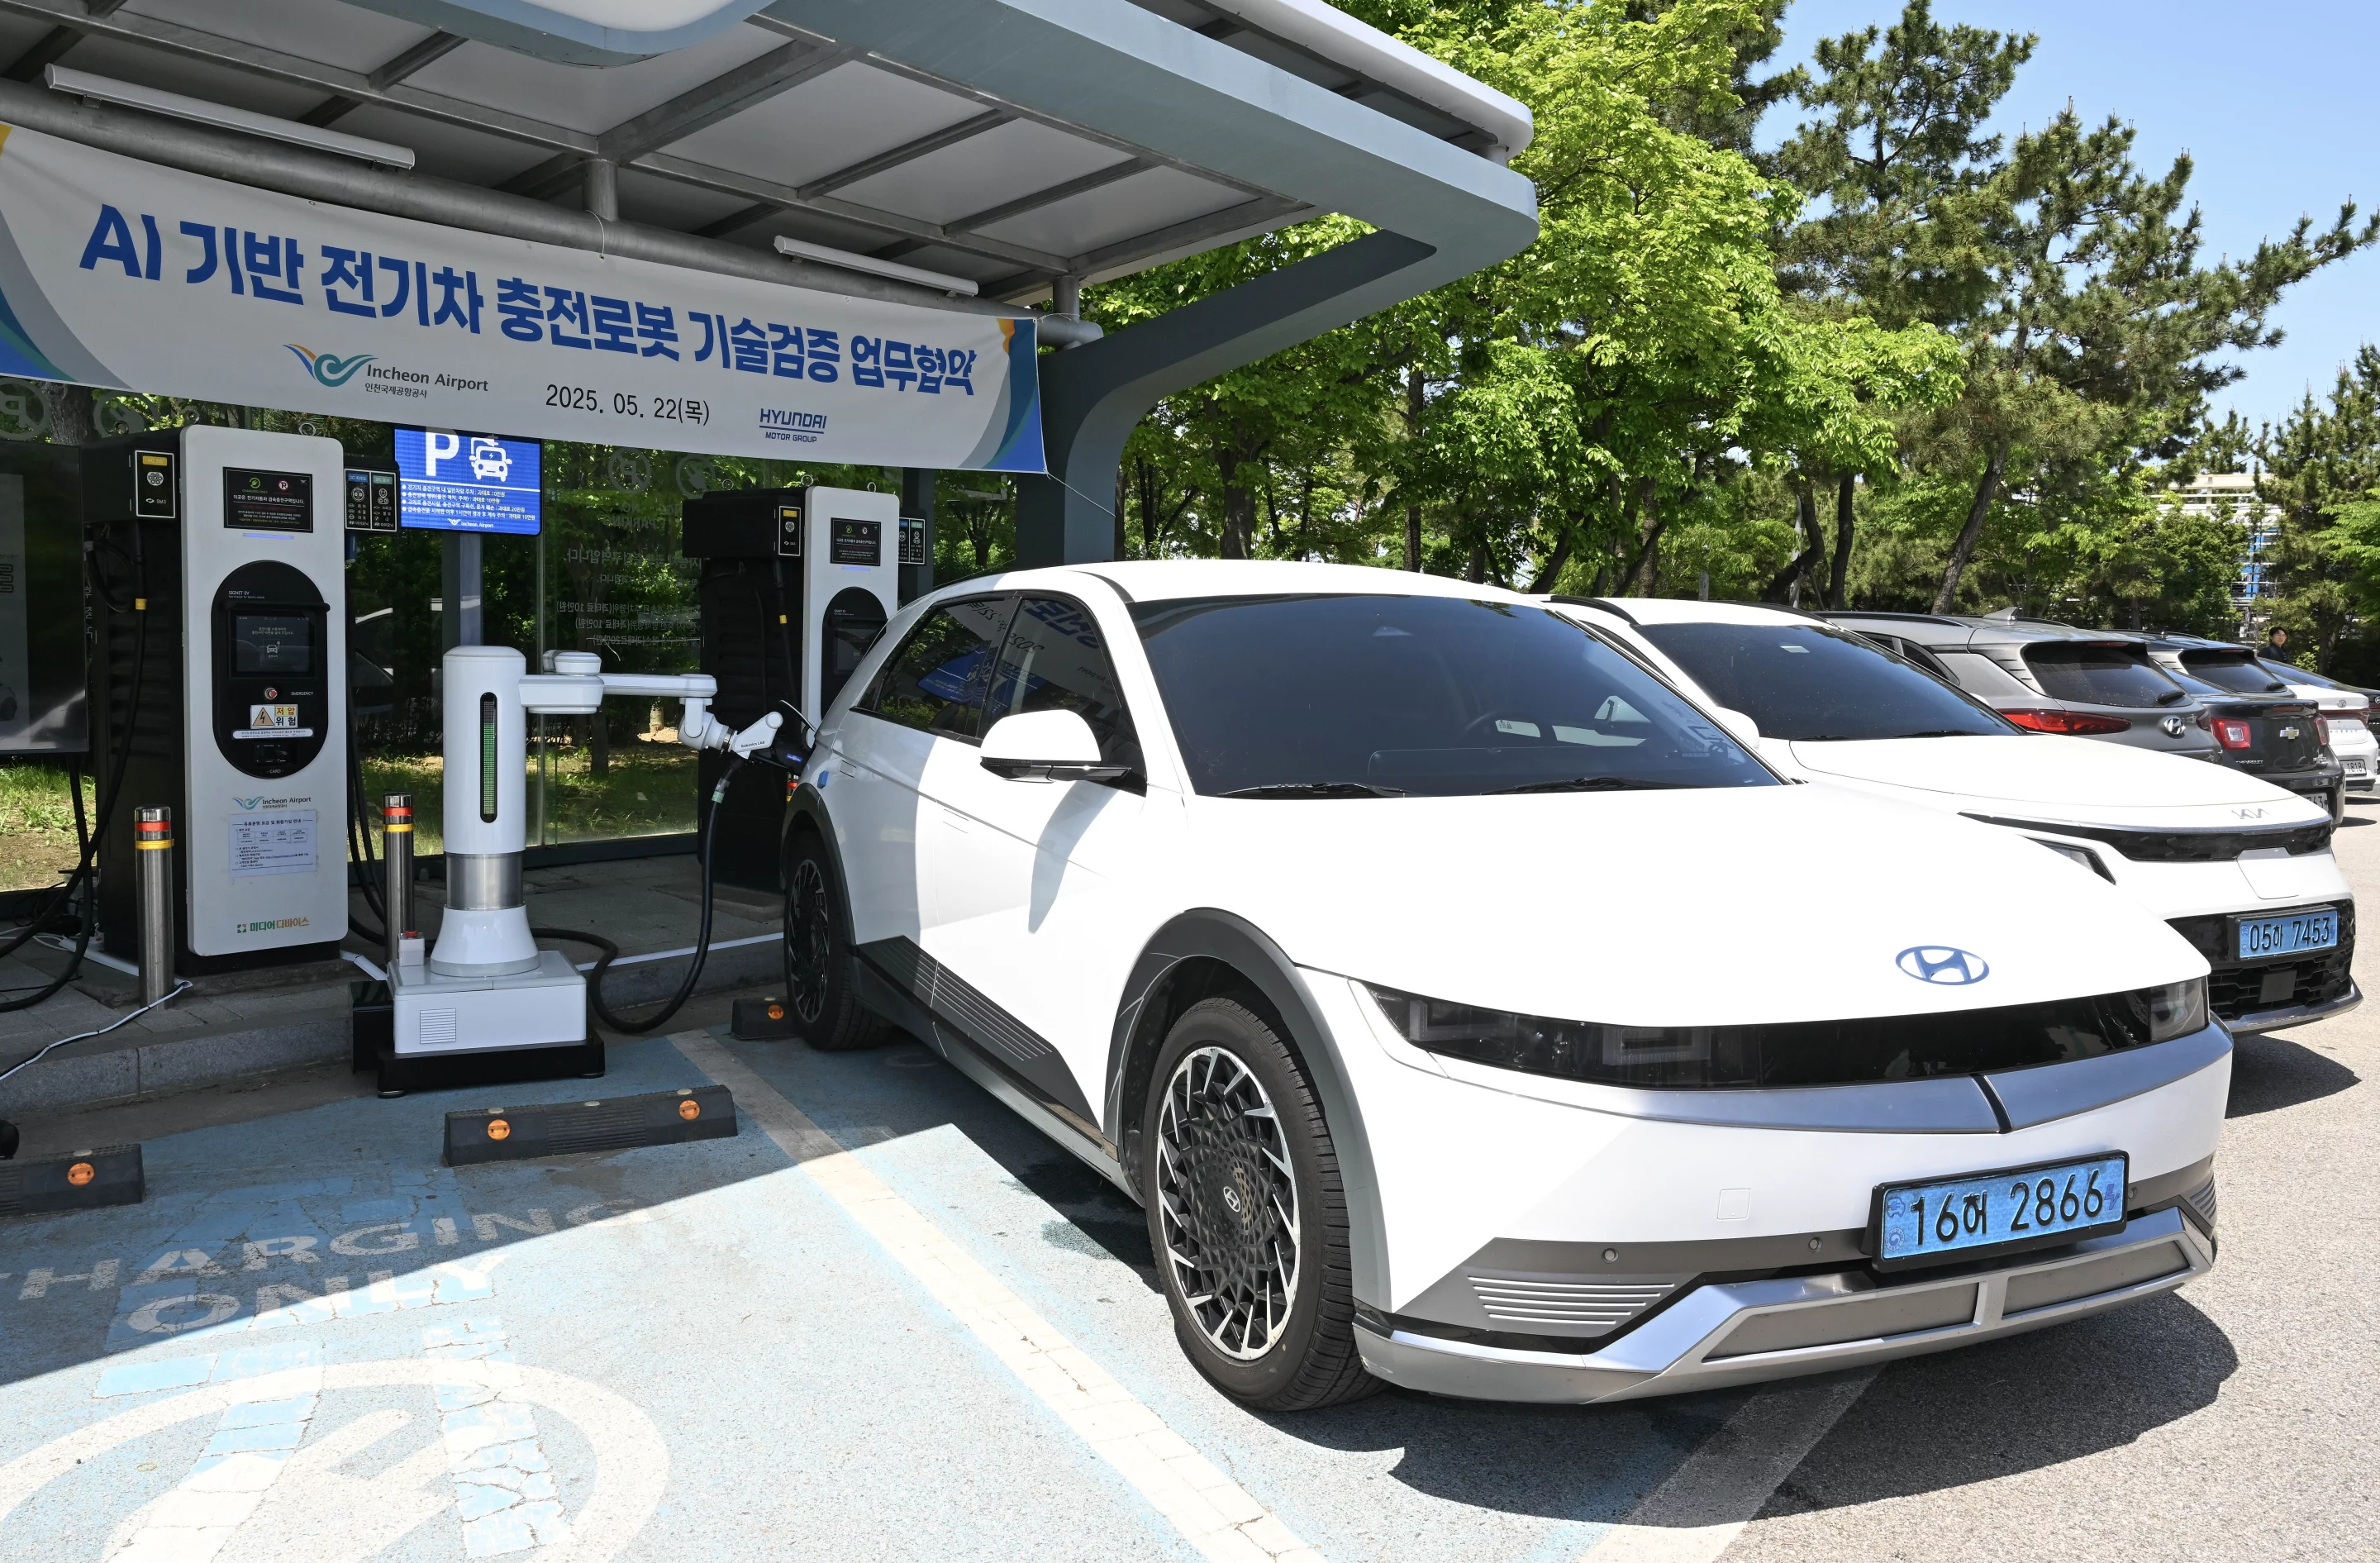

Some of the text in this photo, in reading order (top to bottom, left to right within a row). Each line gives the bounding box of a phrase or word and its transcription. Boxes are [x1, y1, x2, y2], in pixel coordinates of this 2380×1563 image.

[79, 203, 978, 396] AI 기반 전기차 충전로봇 기술검증 업무협약
[364, 382, 428, 399] 인천국제공항공사
[367, 364, 489, 392] Incheon Airport
[545, 384, 710, 426] 2025. 05. 22(목)
[759, 408, 827, 429] HYUNDAI
[426, 426, 459, 477] P
[765, 431, 818, 444] MOTOR GROUP
[2249, 917, 2331, 952] 05하 7453
[1910, 1191, 1988, 1246] 16허
[2010, 1170, 2104, 1232] 2866
[0, 1198, 652, 1301] HARGING
[127, 1253, 511, 1333] ONLY
